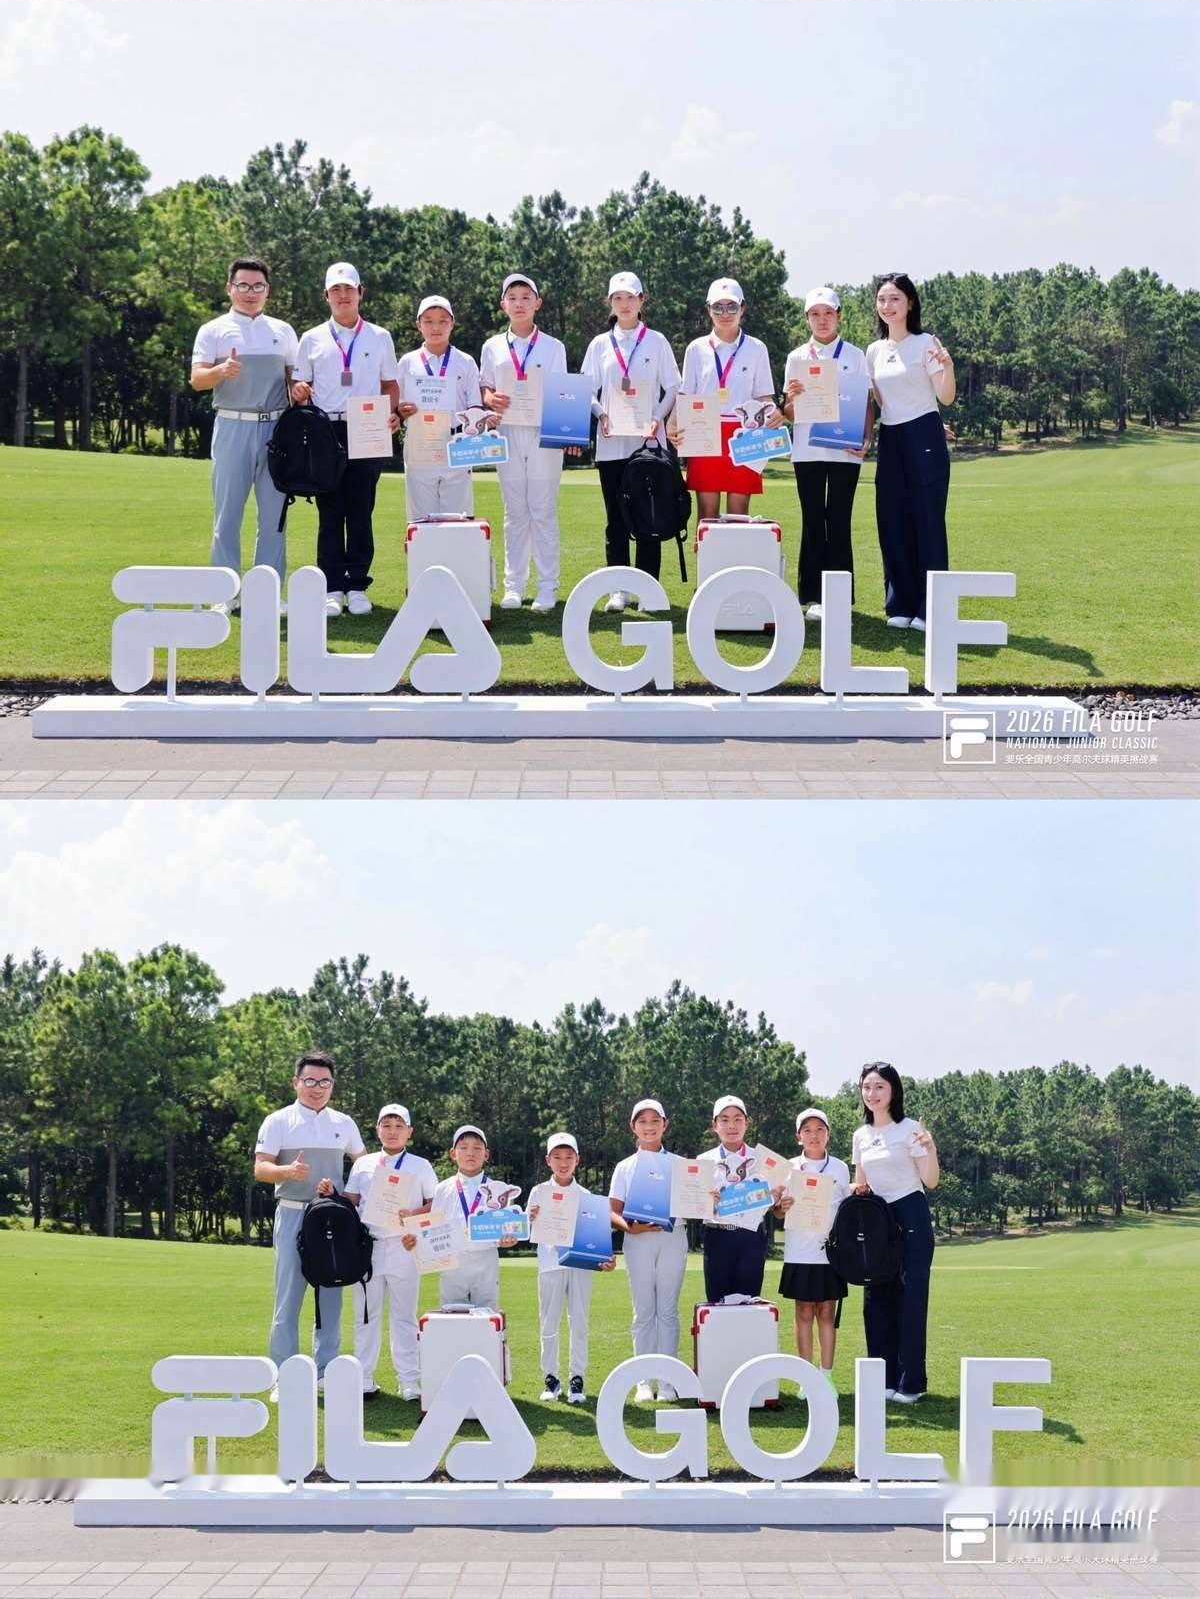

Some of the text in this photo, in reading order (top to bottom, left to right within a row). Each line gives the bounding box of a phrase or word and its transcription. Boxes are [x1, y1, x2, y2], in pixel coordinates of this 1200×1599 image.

[111, 565, 1016, 694] FILA GOLF
[151, 1353, 1052, 1482] FILA GOLF
